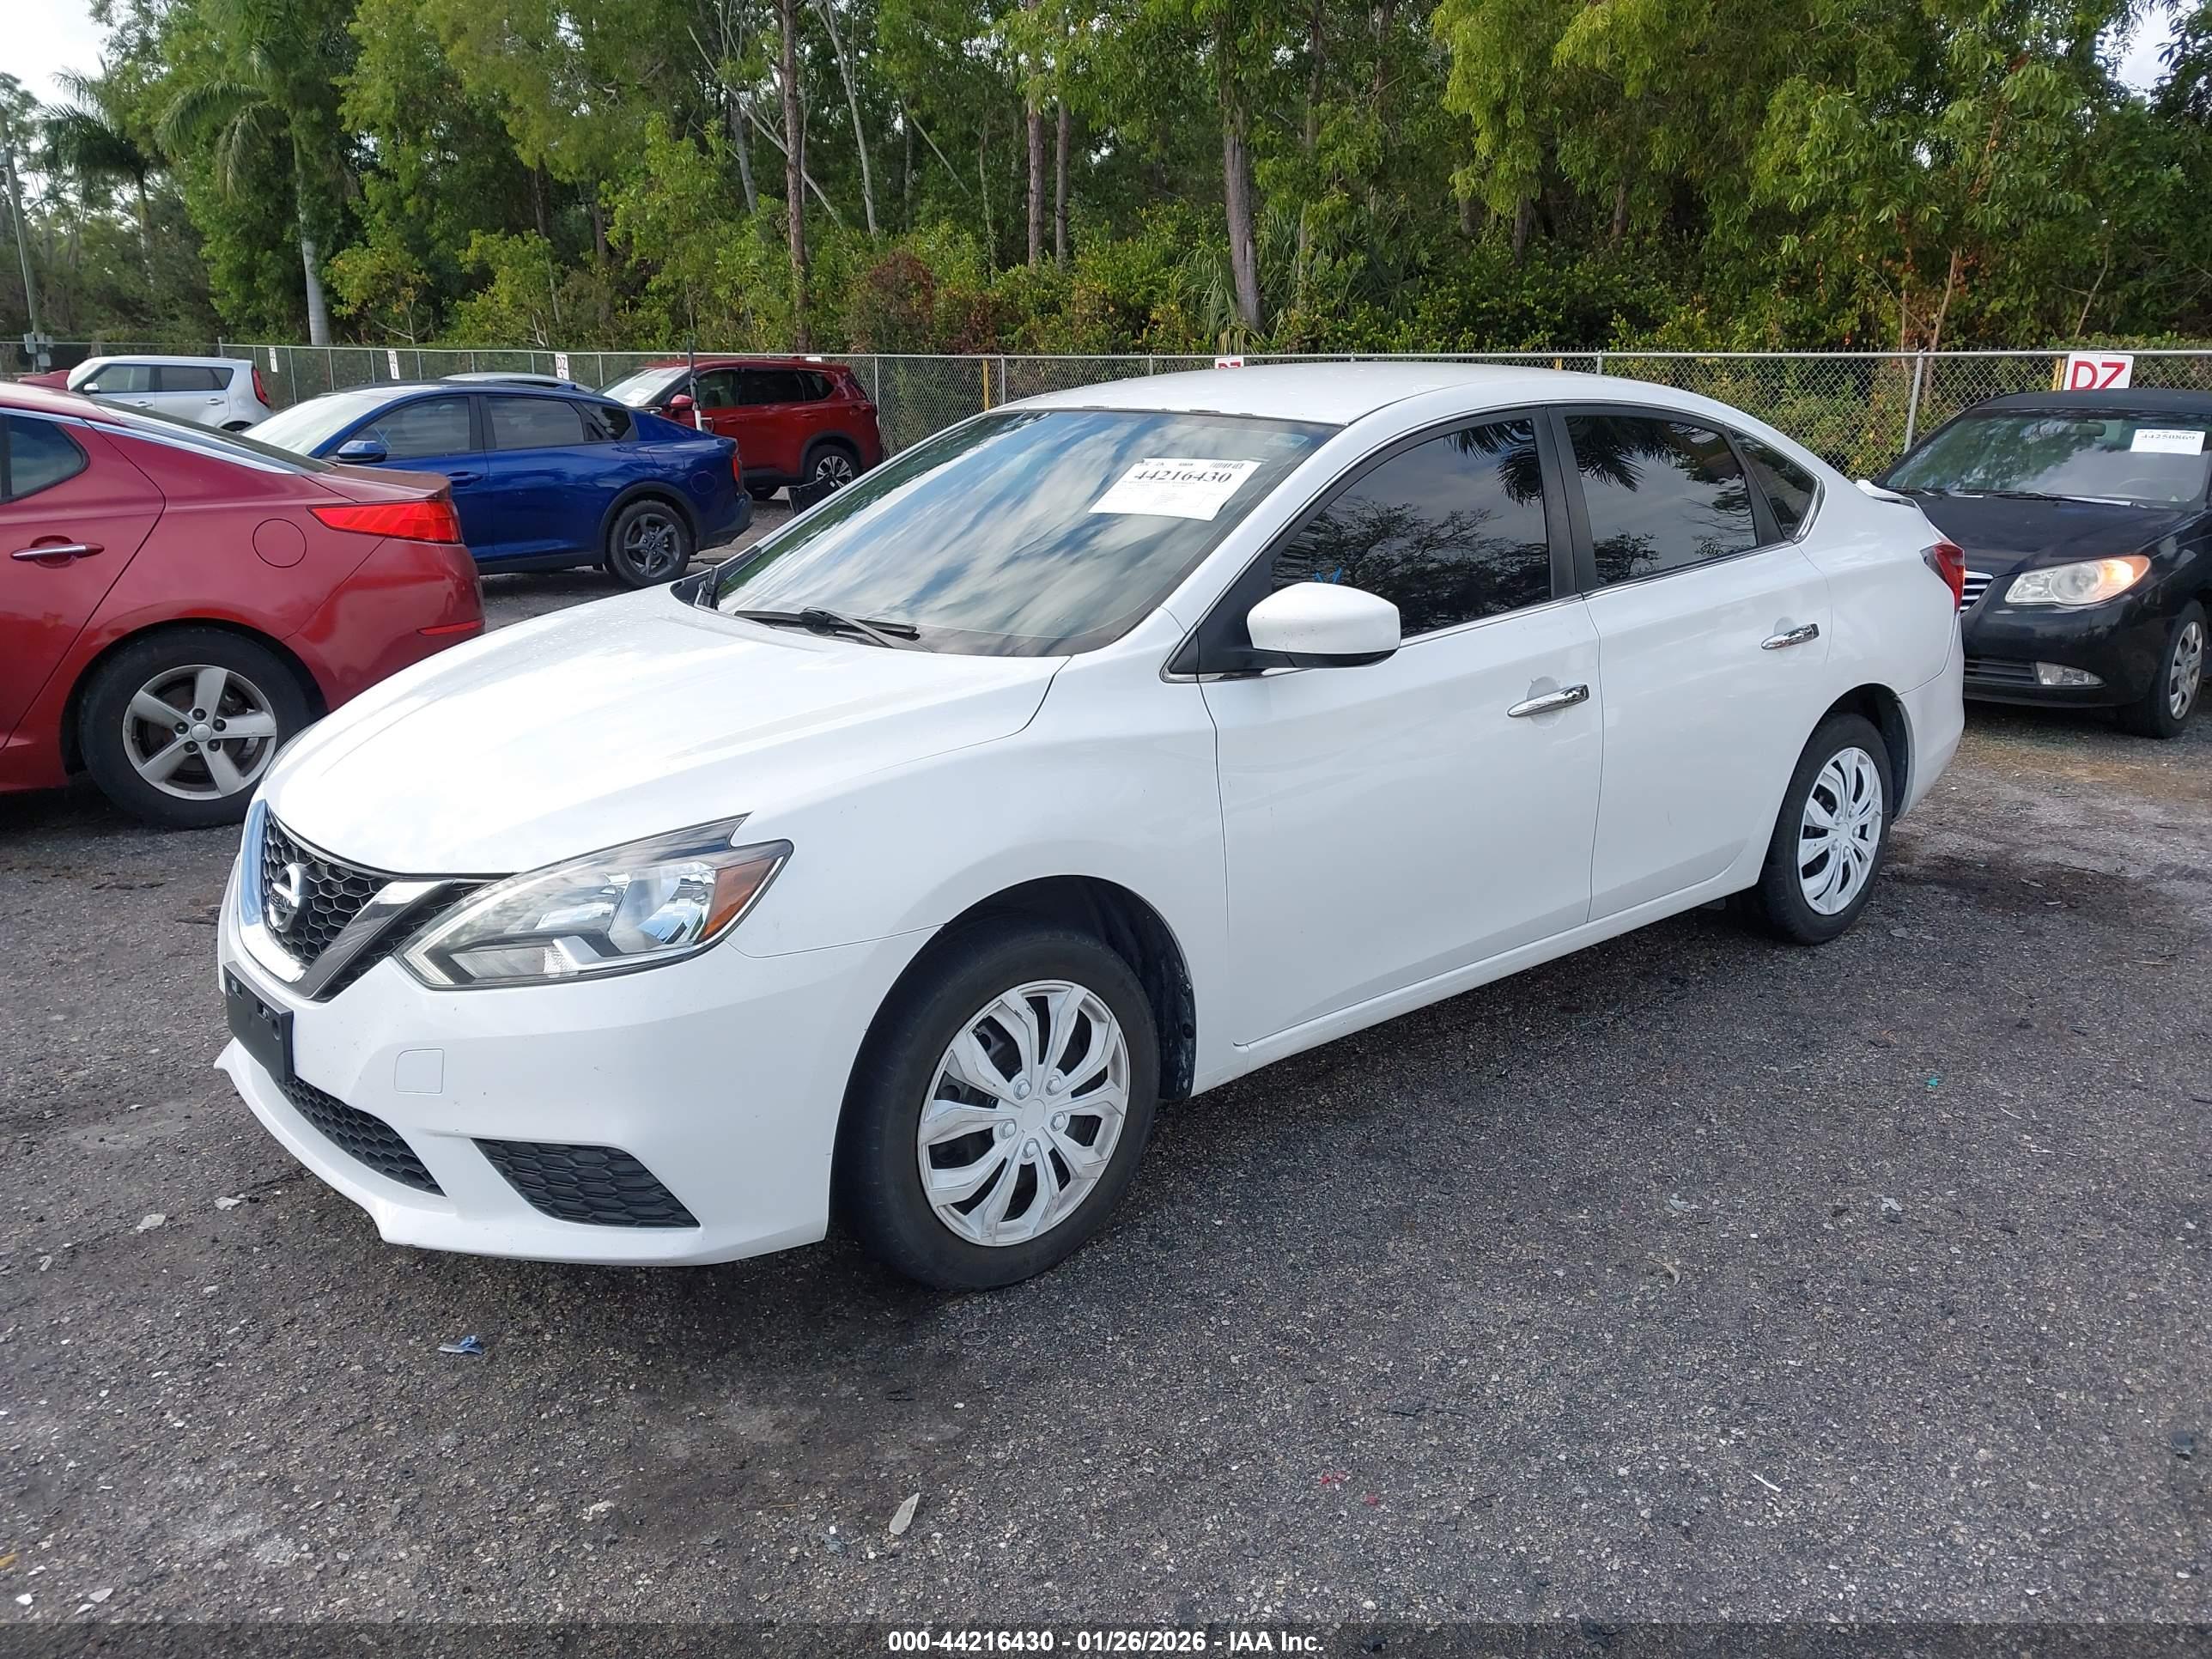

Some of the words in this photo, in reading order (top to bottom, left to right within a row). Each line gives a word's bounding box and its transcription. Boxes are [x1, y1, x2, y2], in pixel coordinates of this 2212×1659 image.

[557, 356, 567, 370] DZ
[2070, 361, 2126, 390] DZ
[1134, 470, 1234, 483] 44216430
